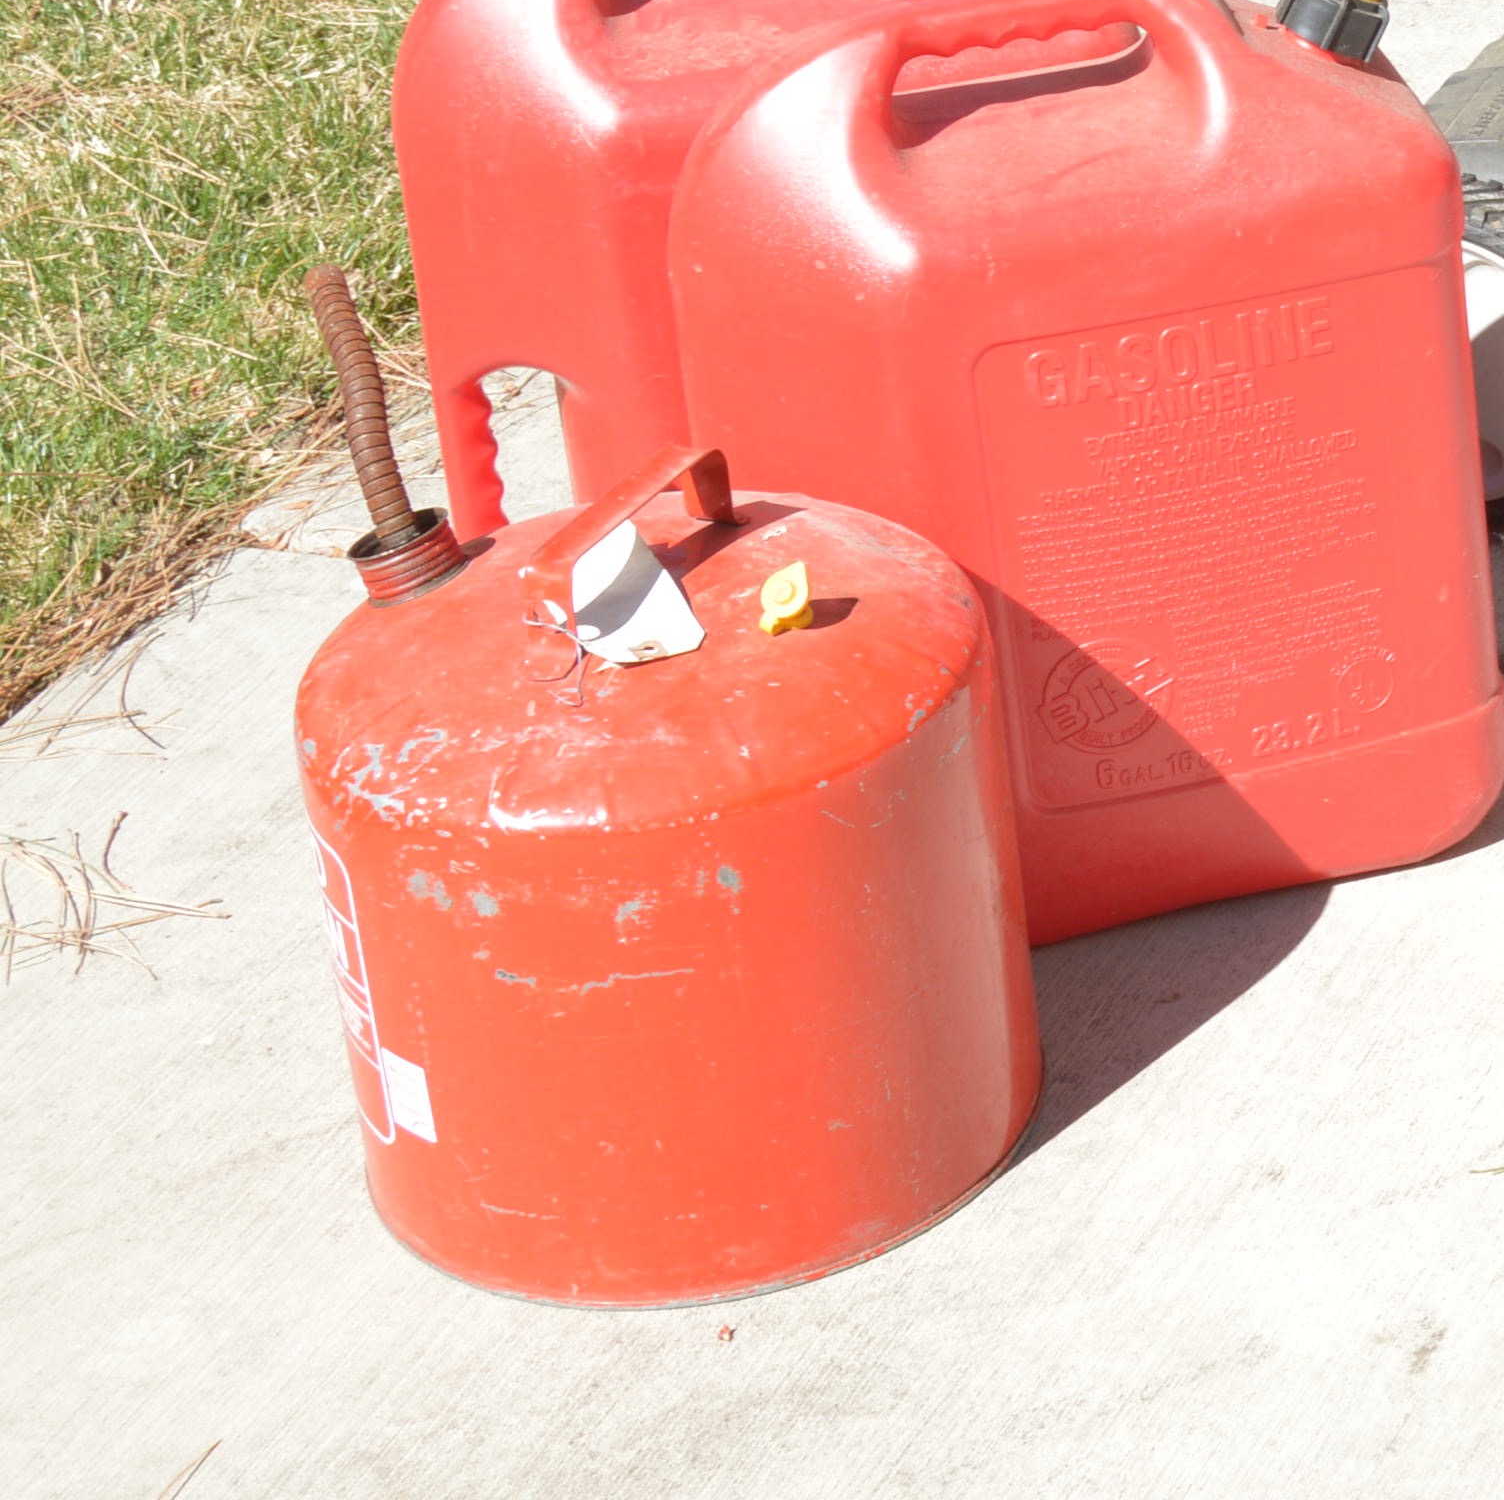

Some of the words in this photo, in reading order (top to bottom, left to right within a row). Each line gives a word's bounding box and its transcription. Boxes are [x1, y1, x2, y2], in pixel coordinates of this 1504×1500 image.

[1024, 296, 1335, 408] GASOLINE
[1083, 418, 1187, 457] EXTREMELY
[1191, 394, 1298, 436] FLAMMABLE
[1117, 371, 1257, 430] DANGER
[1039, 478, 1127, 512] HARMFUL
[1165, 459, 1225, 490] FATAL
[1250, 426, 1359, 470] SWALLOWED
[1091, 447, 1165, 480] VAPORS
[1216, 419, 1297, 455] EXPLODE
[1251, 711, 1327, 759] 23.2
[1096, 757, 1115, 790] 6
[1166, 749, 1193, 777] 16
